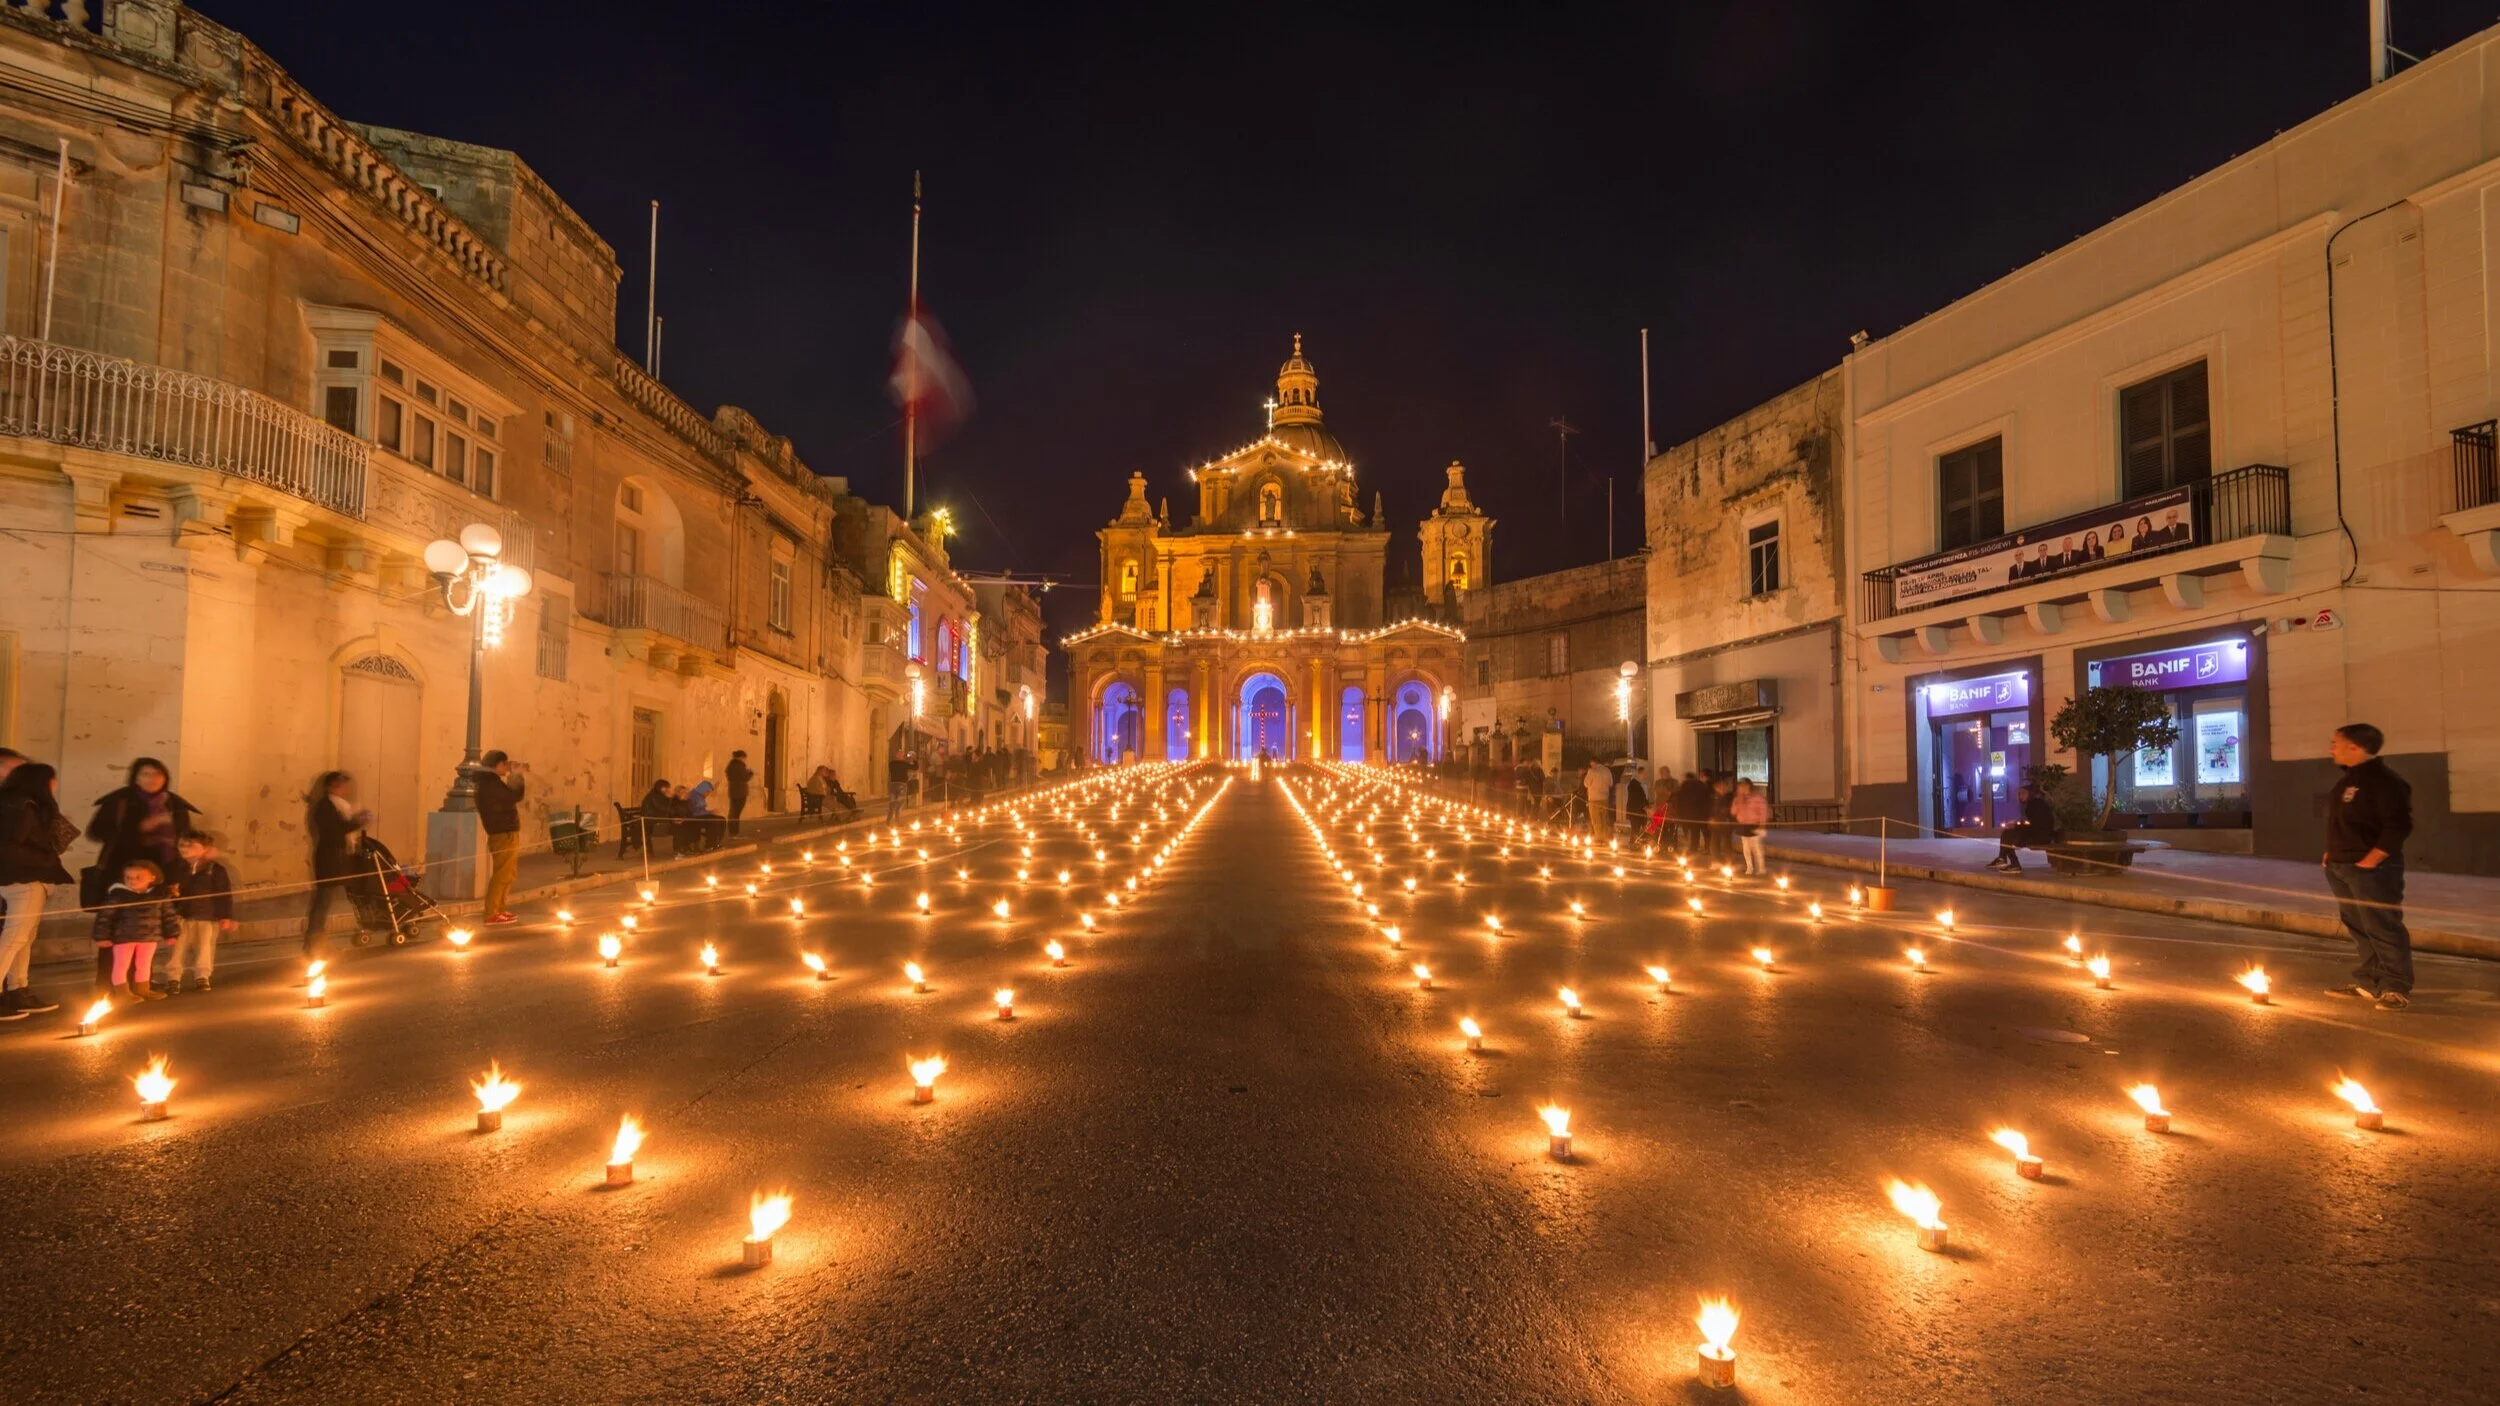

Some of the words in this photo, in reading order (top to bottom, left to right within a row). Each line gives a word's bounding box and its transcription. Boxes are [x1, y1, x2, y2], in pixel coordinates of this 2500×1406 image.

[2131, 658, 2190, 678] BANIF
[2132, 677, 2159, 687] BANK
[1949, 686, 1991, 702] BANIF
